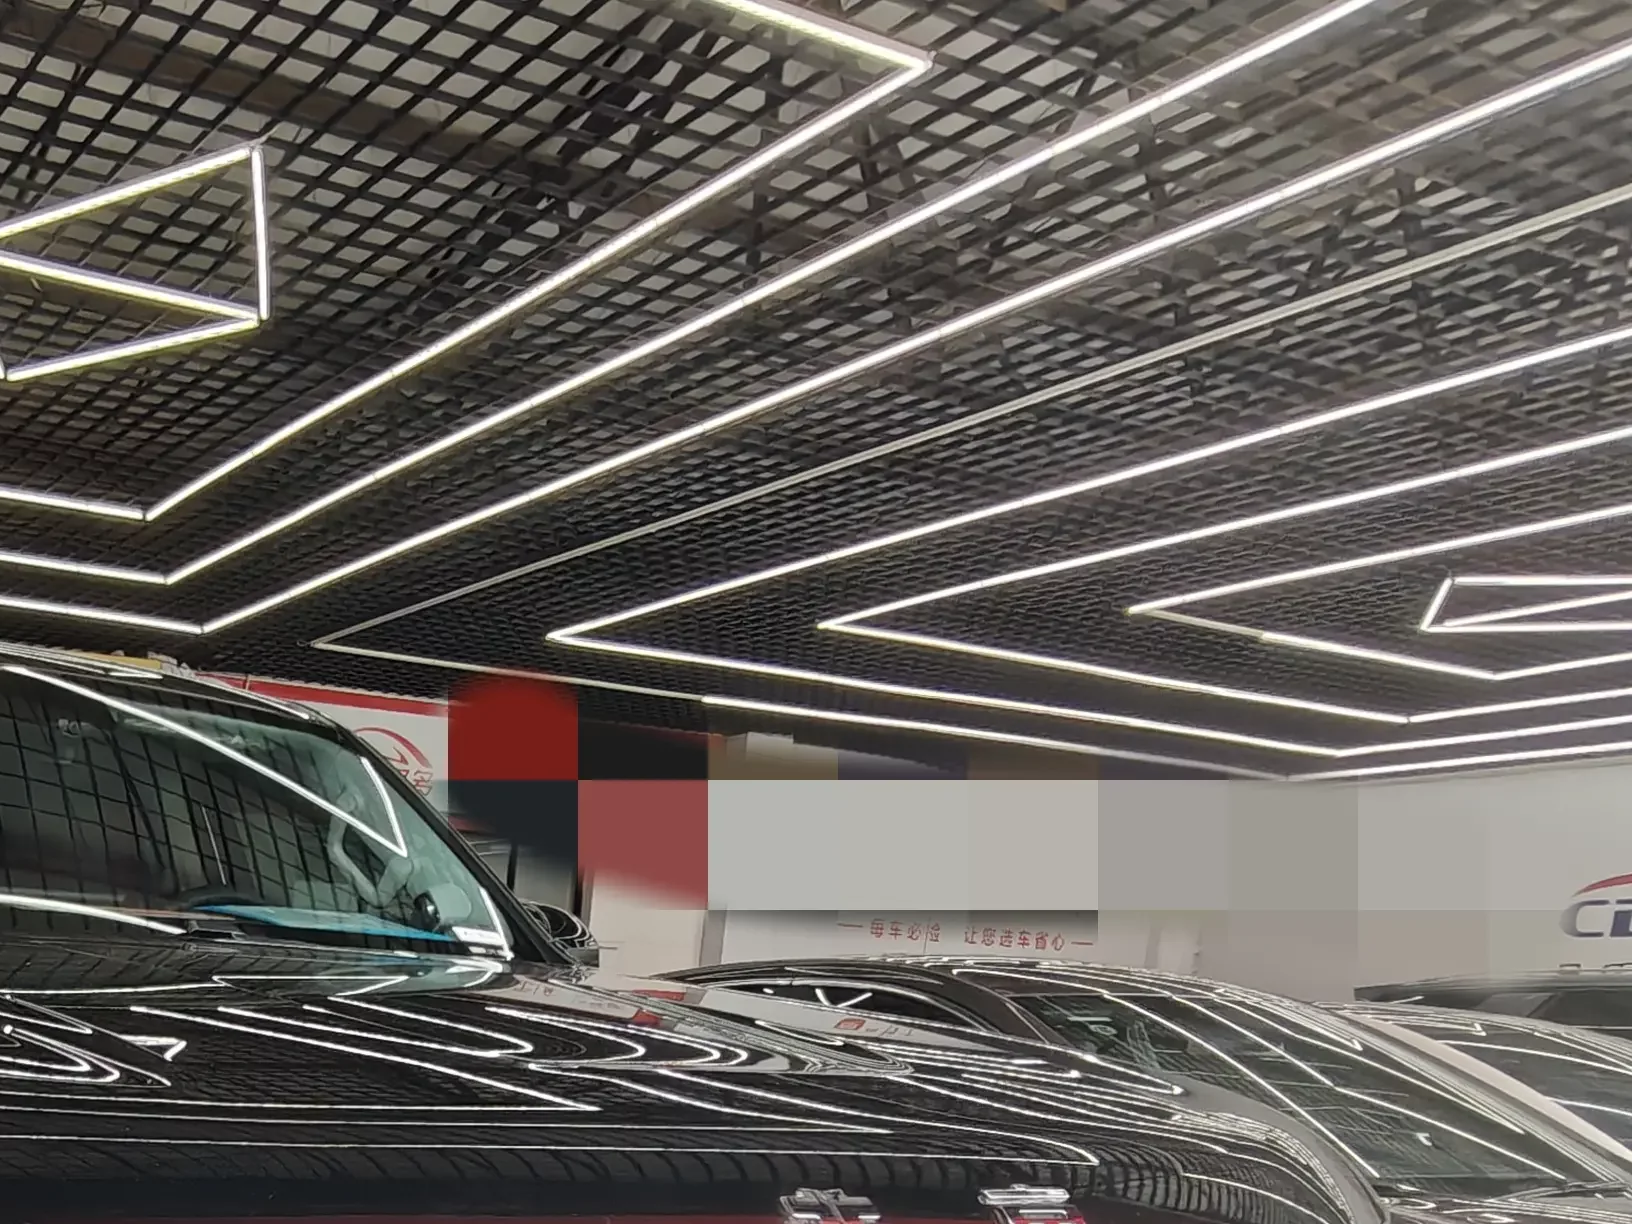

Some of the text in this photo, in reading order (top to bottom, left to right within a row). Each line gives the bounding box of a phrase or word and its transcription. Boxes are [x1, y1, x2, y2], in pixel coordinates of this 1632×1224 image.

[964, 926, 1066, 951] 让您选车省心
